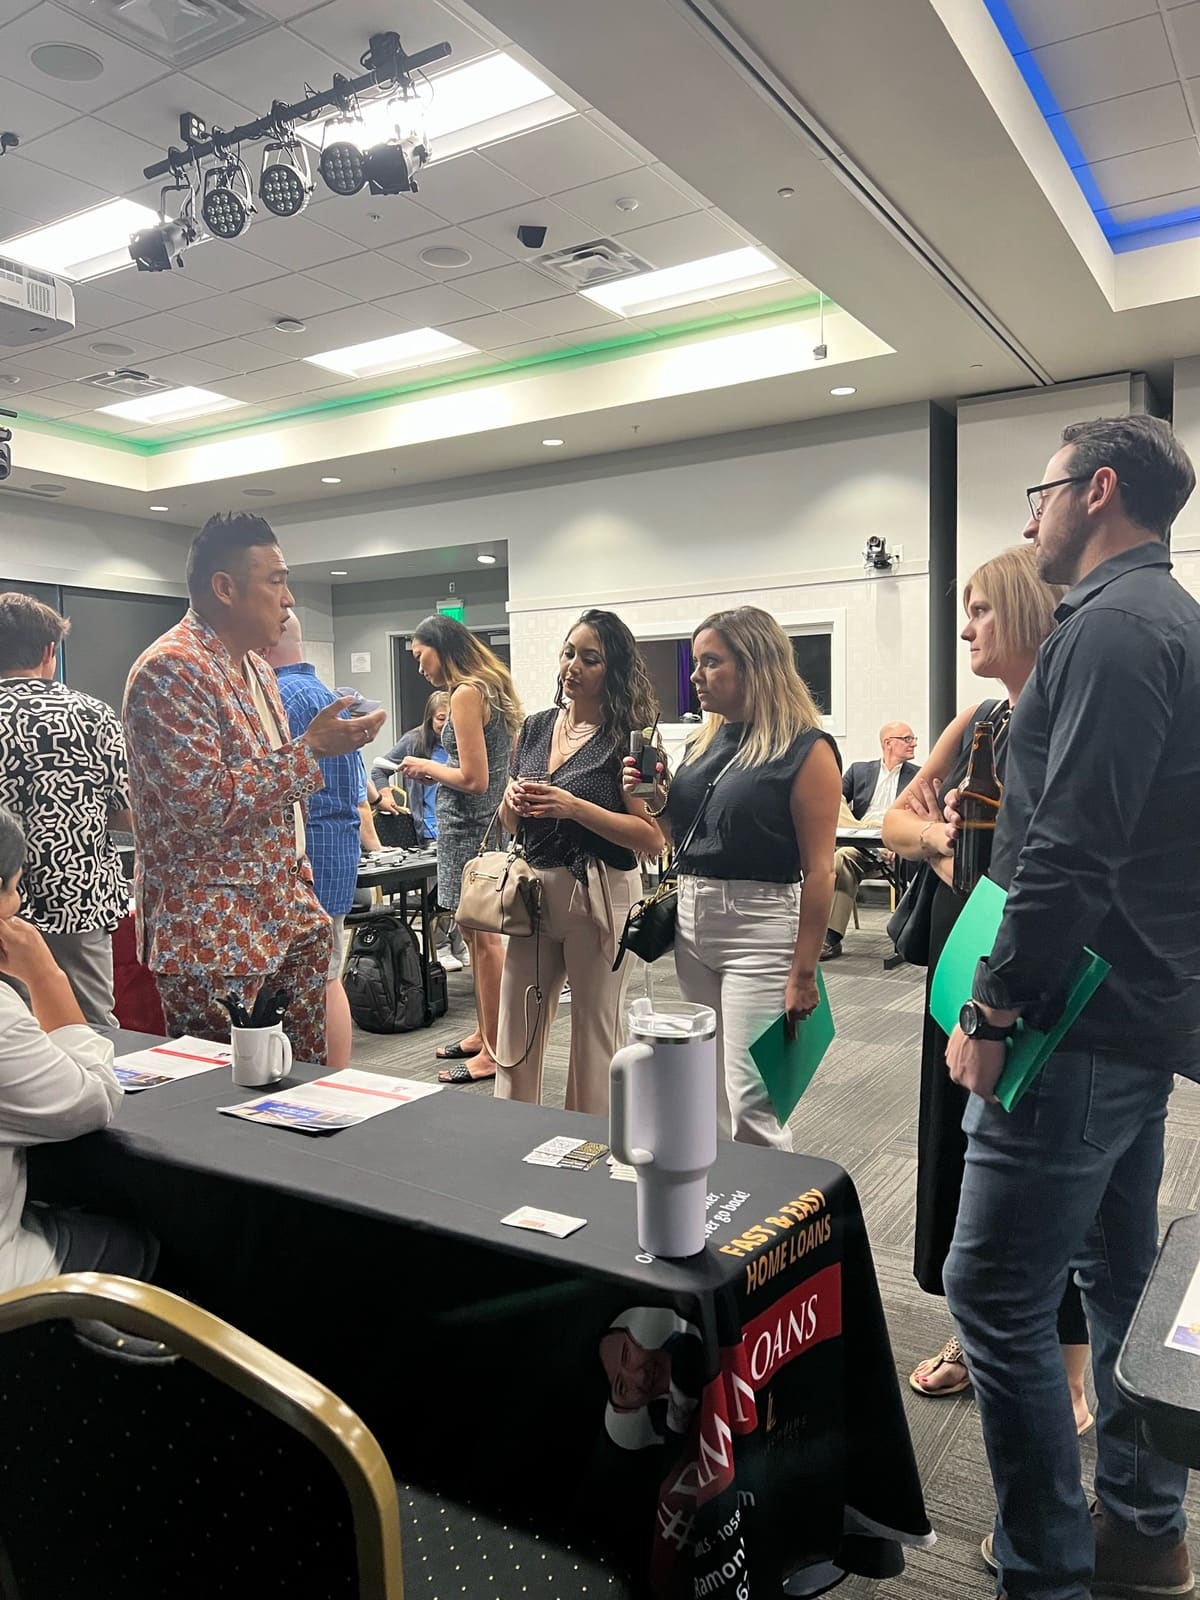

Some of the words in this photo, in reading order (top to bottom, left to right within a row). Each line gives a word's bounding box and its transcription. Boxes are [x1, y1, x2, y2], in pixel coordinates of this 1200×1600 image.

[719, 1190, 751, 1212] back!
[778, 1188, 827, 1222] EASY
[713, 1210, 732, 1223] go
[763, 1215, 795, 1230] &
[719, 1225, 777, 1258] FAST
[746, 1244, 787, 1295] HOME
[789, 1213, 832, 1265] LOANS
